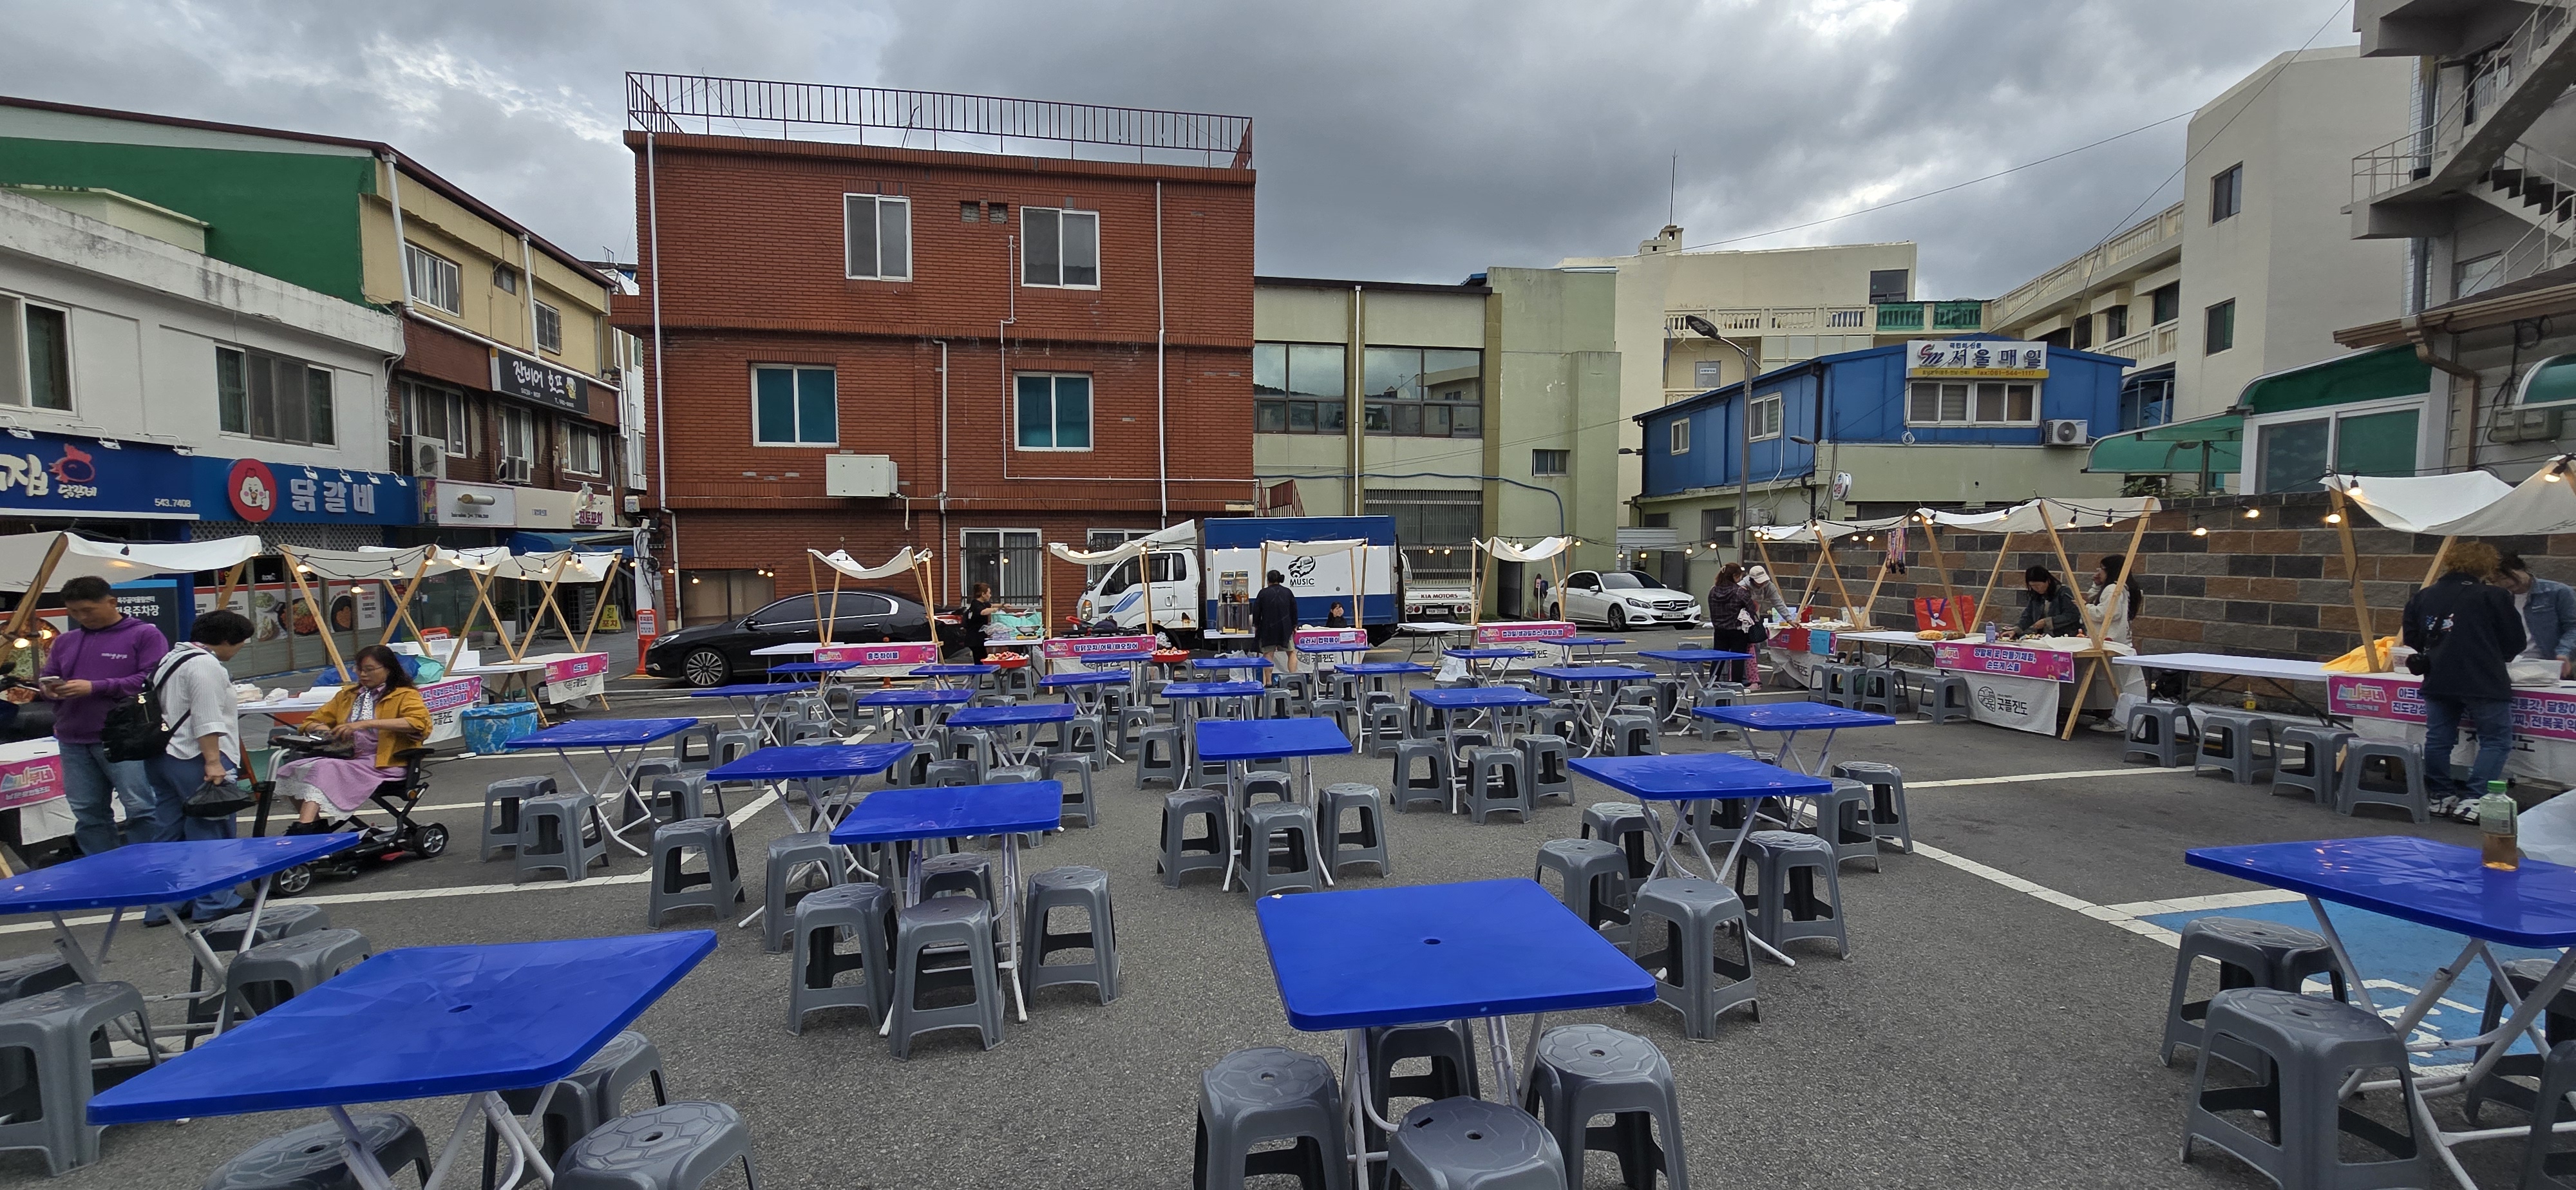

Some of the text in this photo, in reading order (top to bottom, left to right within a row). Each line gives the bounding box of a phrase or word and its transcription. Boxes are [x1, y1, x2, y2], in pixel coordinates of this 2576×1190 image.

[1951, 349, 2041, 368] 서울매일
[513, 361, 565, 395] 잔비어 호프
[0, 453, 49, 496] 집
[290, 479, 375, 514] 닭갈비
[2531, 715, 2564, 730] 전복꽃
